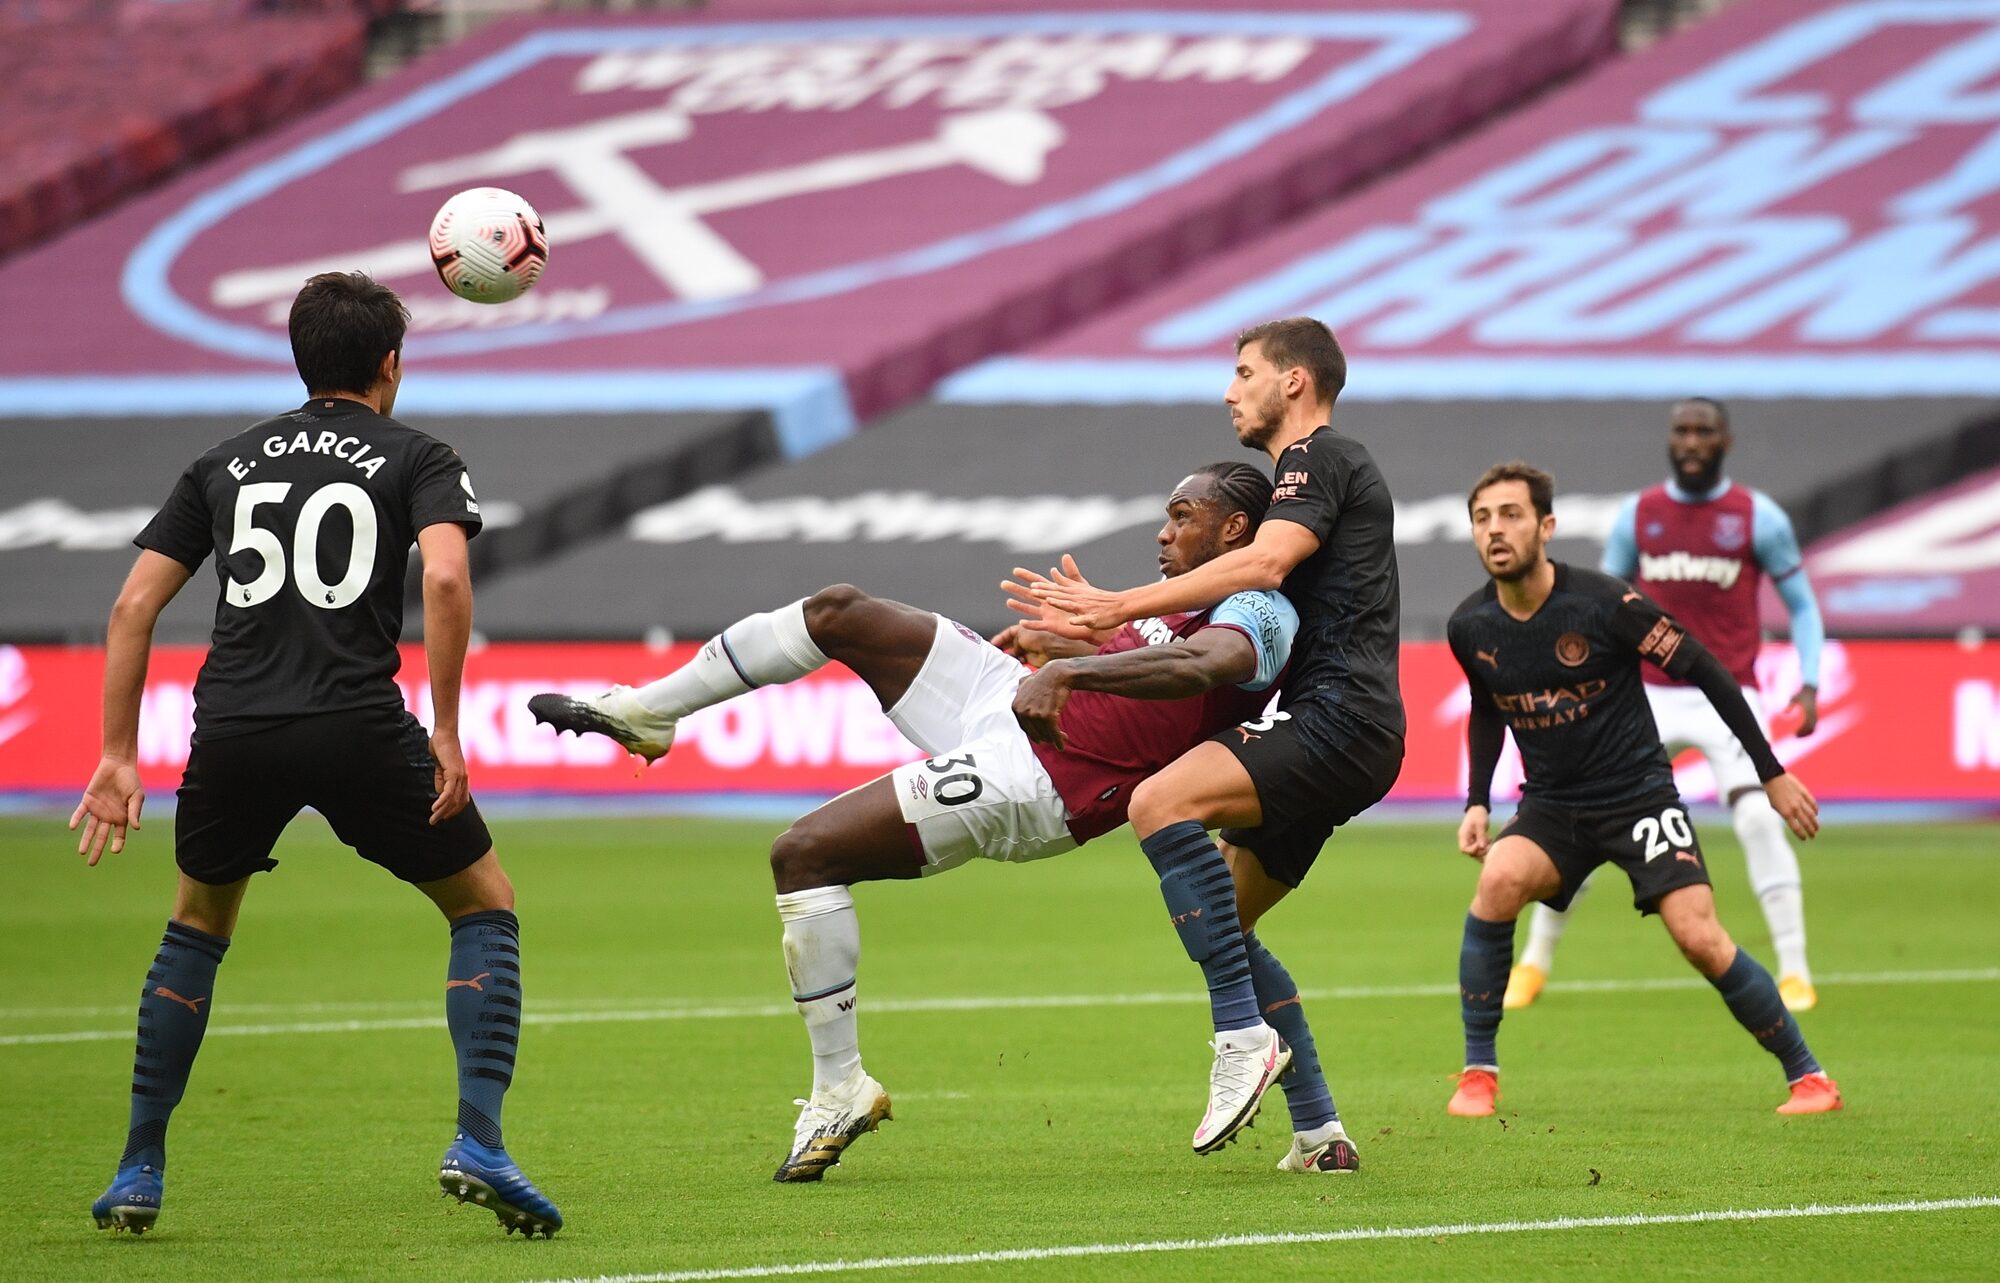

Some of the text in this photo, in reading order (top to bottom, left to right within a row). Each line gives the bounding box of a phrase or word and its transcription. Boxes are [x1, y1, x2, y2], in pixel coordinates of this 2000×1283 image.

[226, 430, 387, 481] E. GARCIA
[225, 482, 378, 609] 50
[1639, 551, 1742, 591] betway
[1513, 703, 1590, 731] AIRWAYS
[925, 753, 984, 806] 30
[1632, 808, 1693, 864] 20
[128, 1193, 156, 1203] COPA
